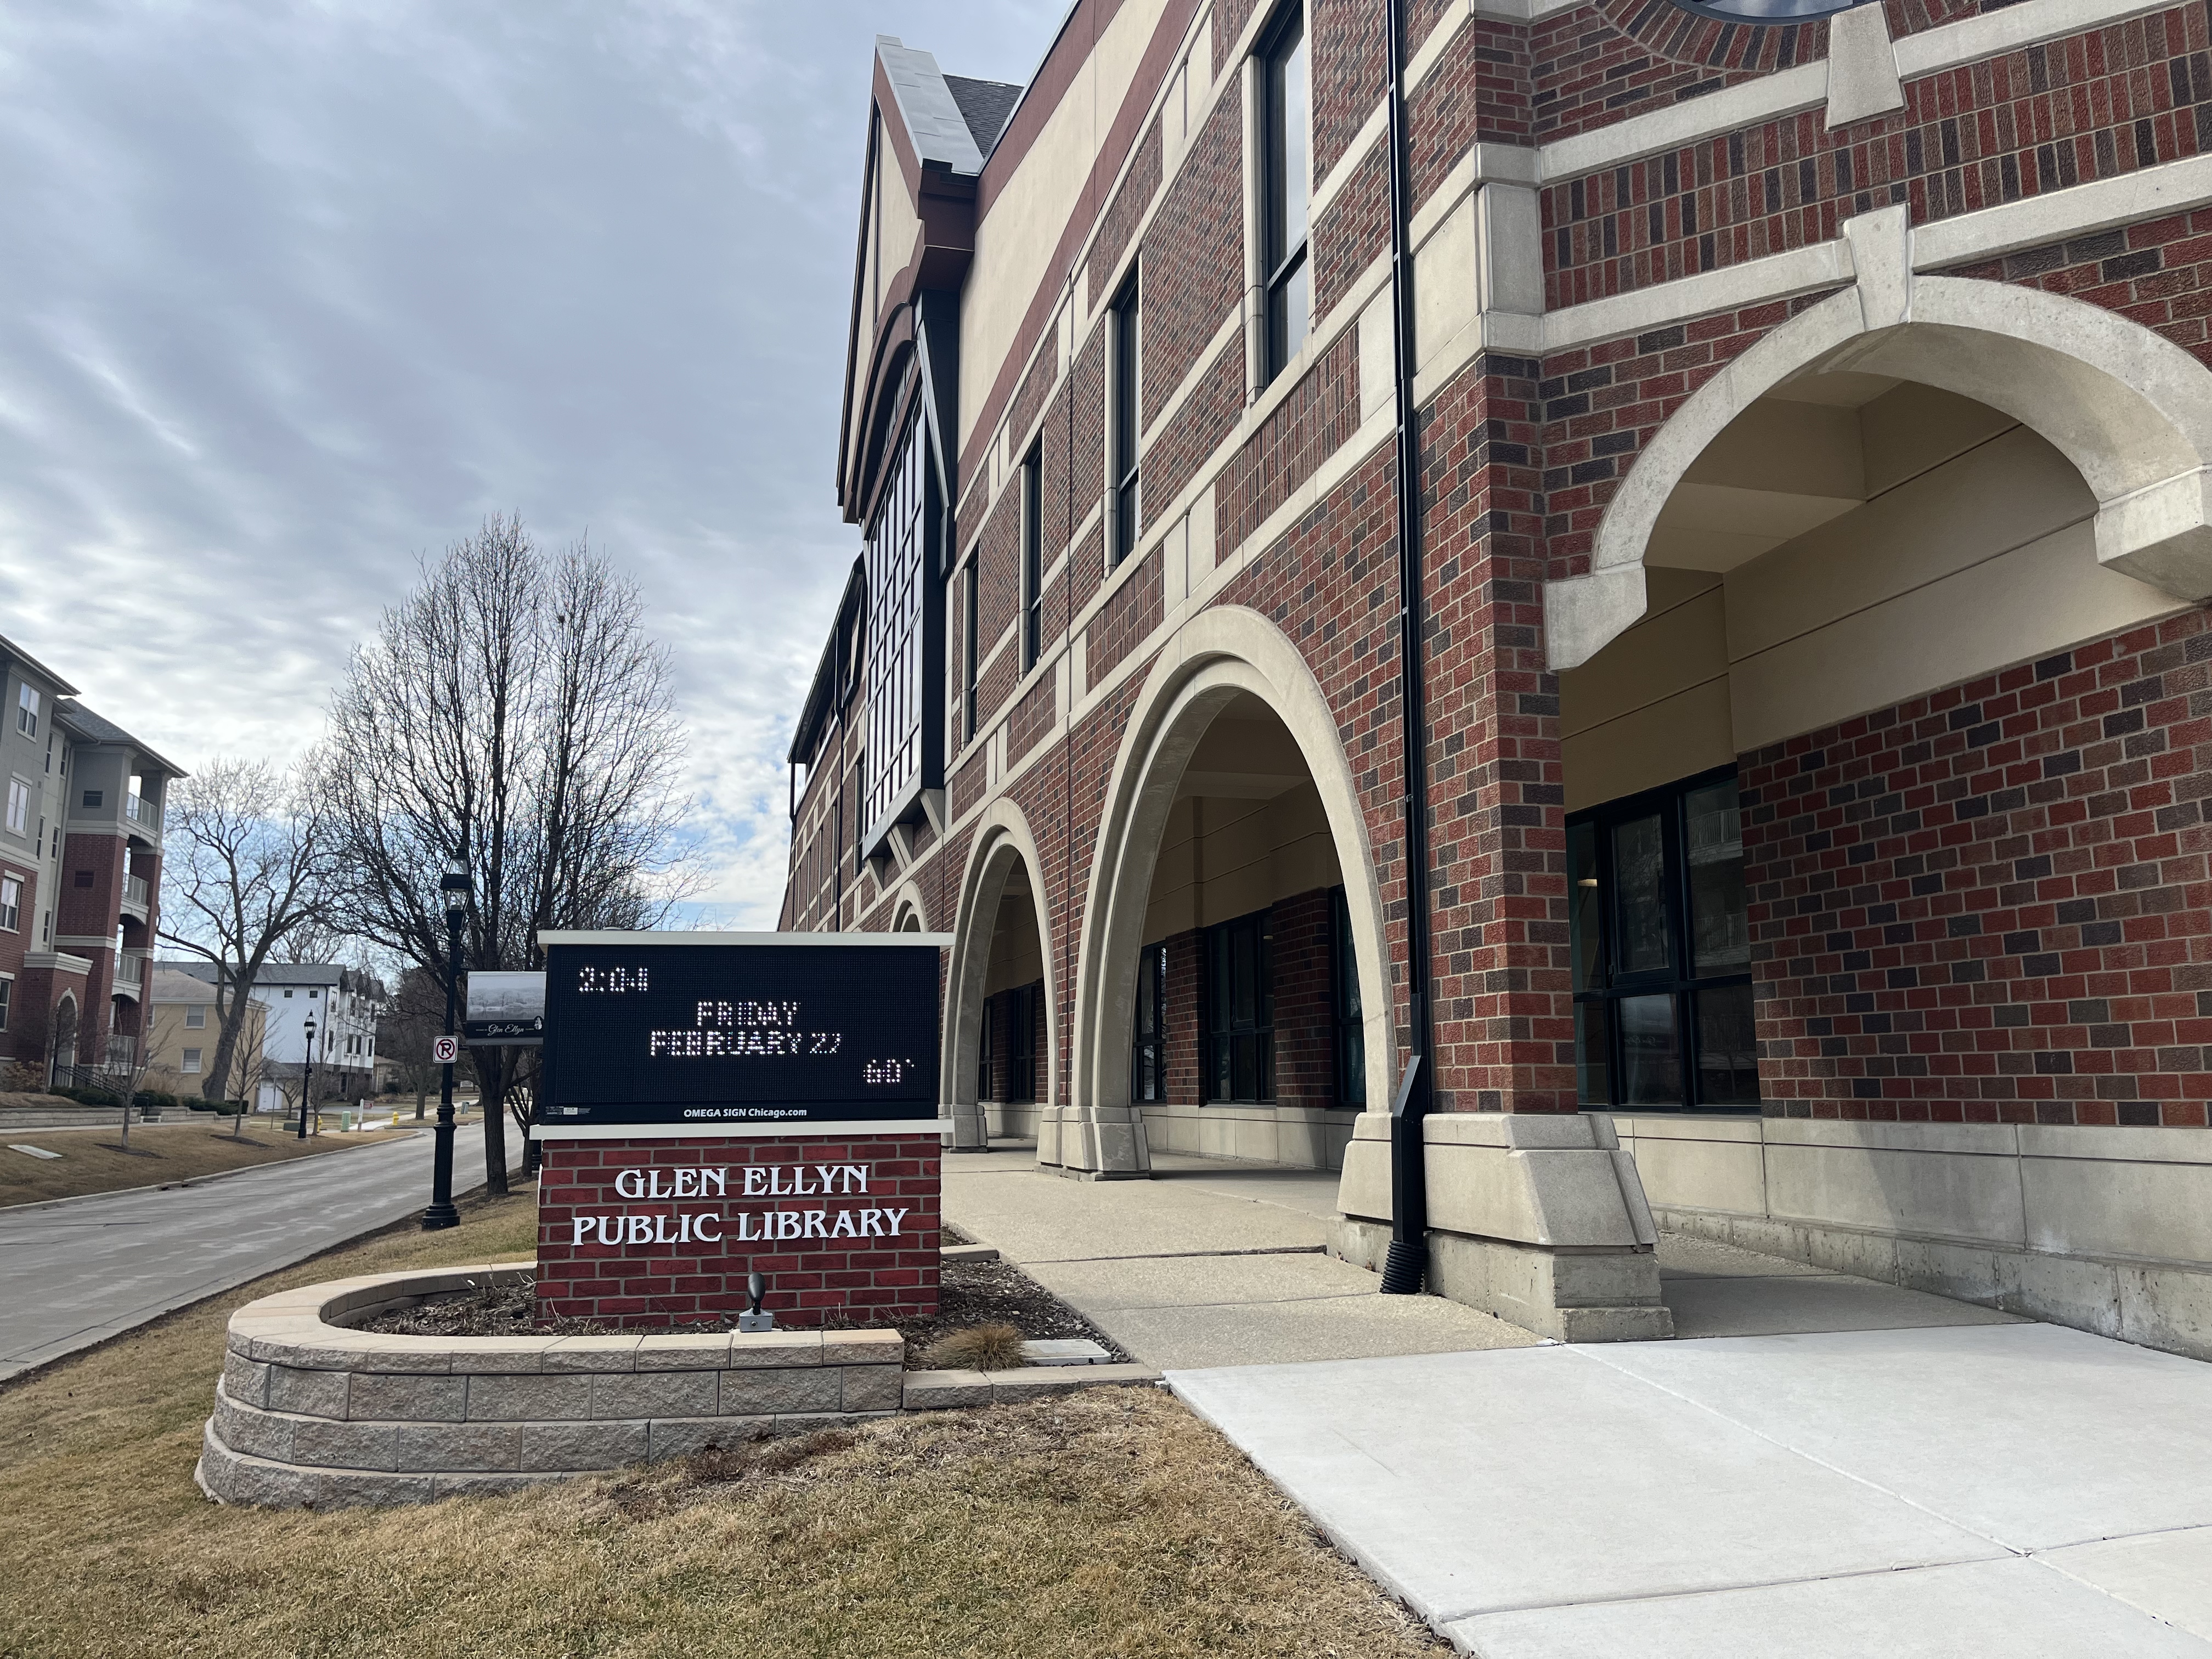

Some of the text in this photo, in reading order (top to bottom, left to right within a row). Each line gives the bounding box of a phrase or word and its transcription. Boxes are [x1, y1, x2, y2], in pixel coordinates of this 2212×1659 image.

[579, 967, 648, 992] 2:04
[697, 1001, 800, 1026] FRIDAY
[487, 1024, 524, 1036] Glen Ellyn
[651, 1030, 803, 1056] FEBRUARY
[684, 1108, 807, 1119] OMEGA SIGN Chicago.com
[614, 1165, 870, 1199] GLEN ELLYN
[571, 1208, 910, 1246] PUBLIC LIBRARY
